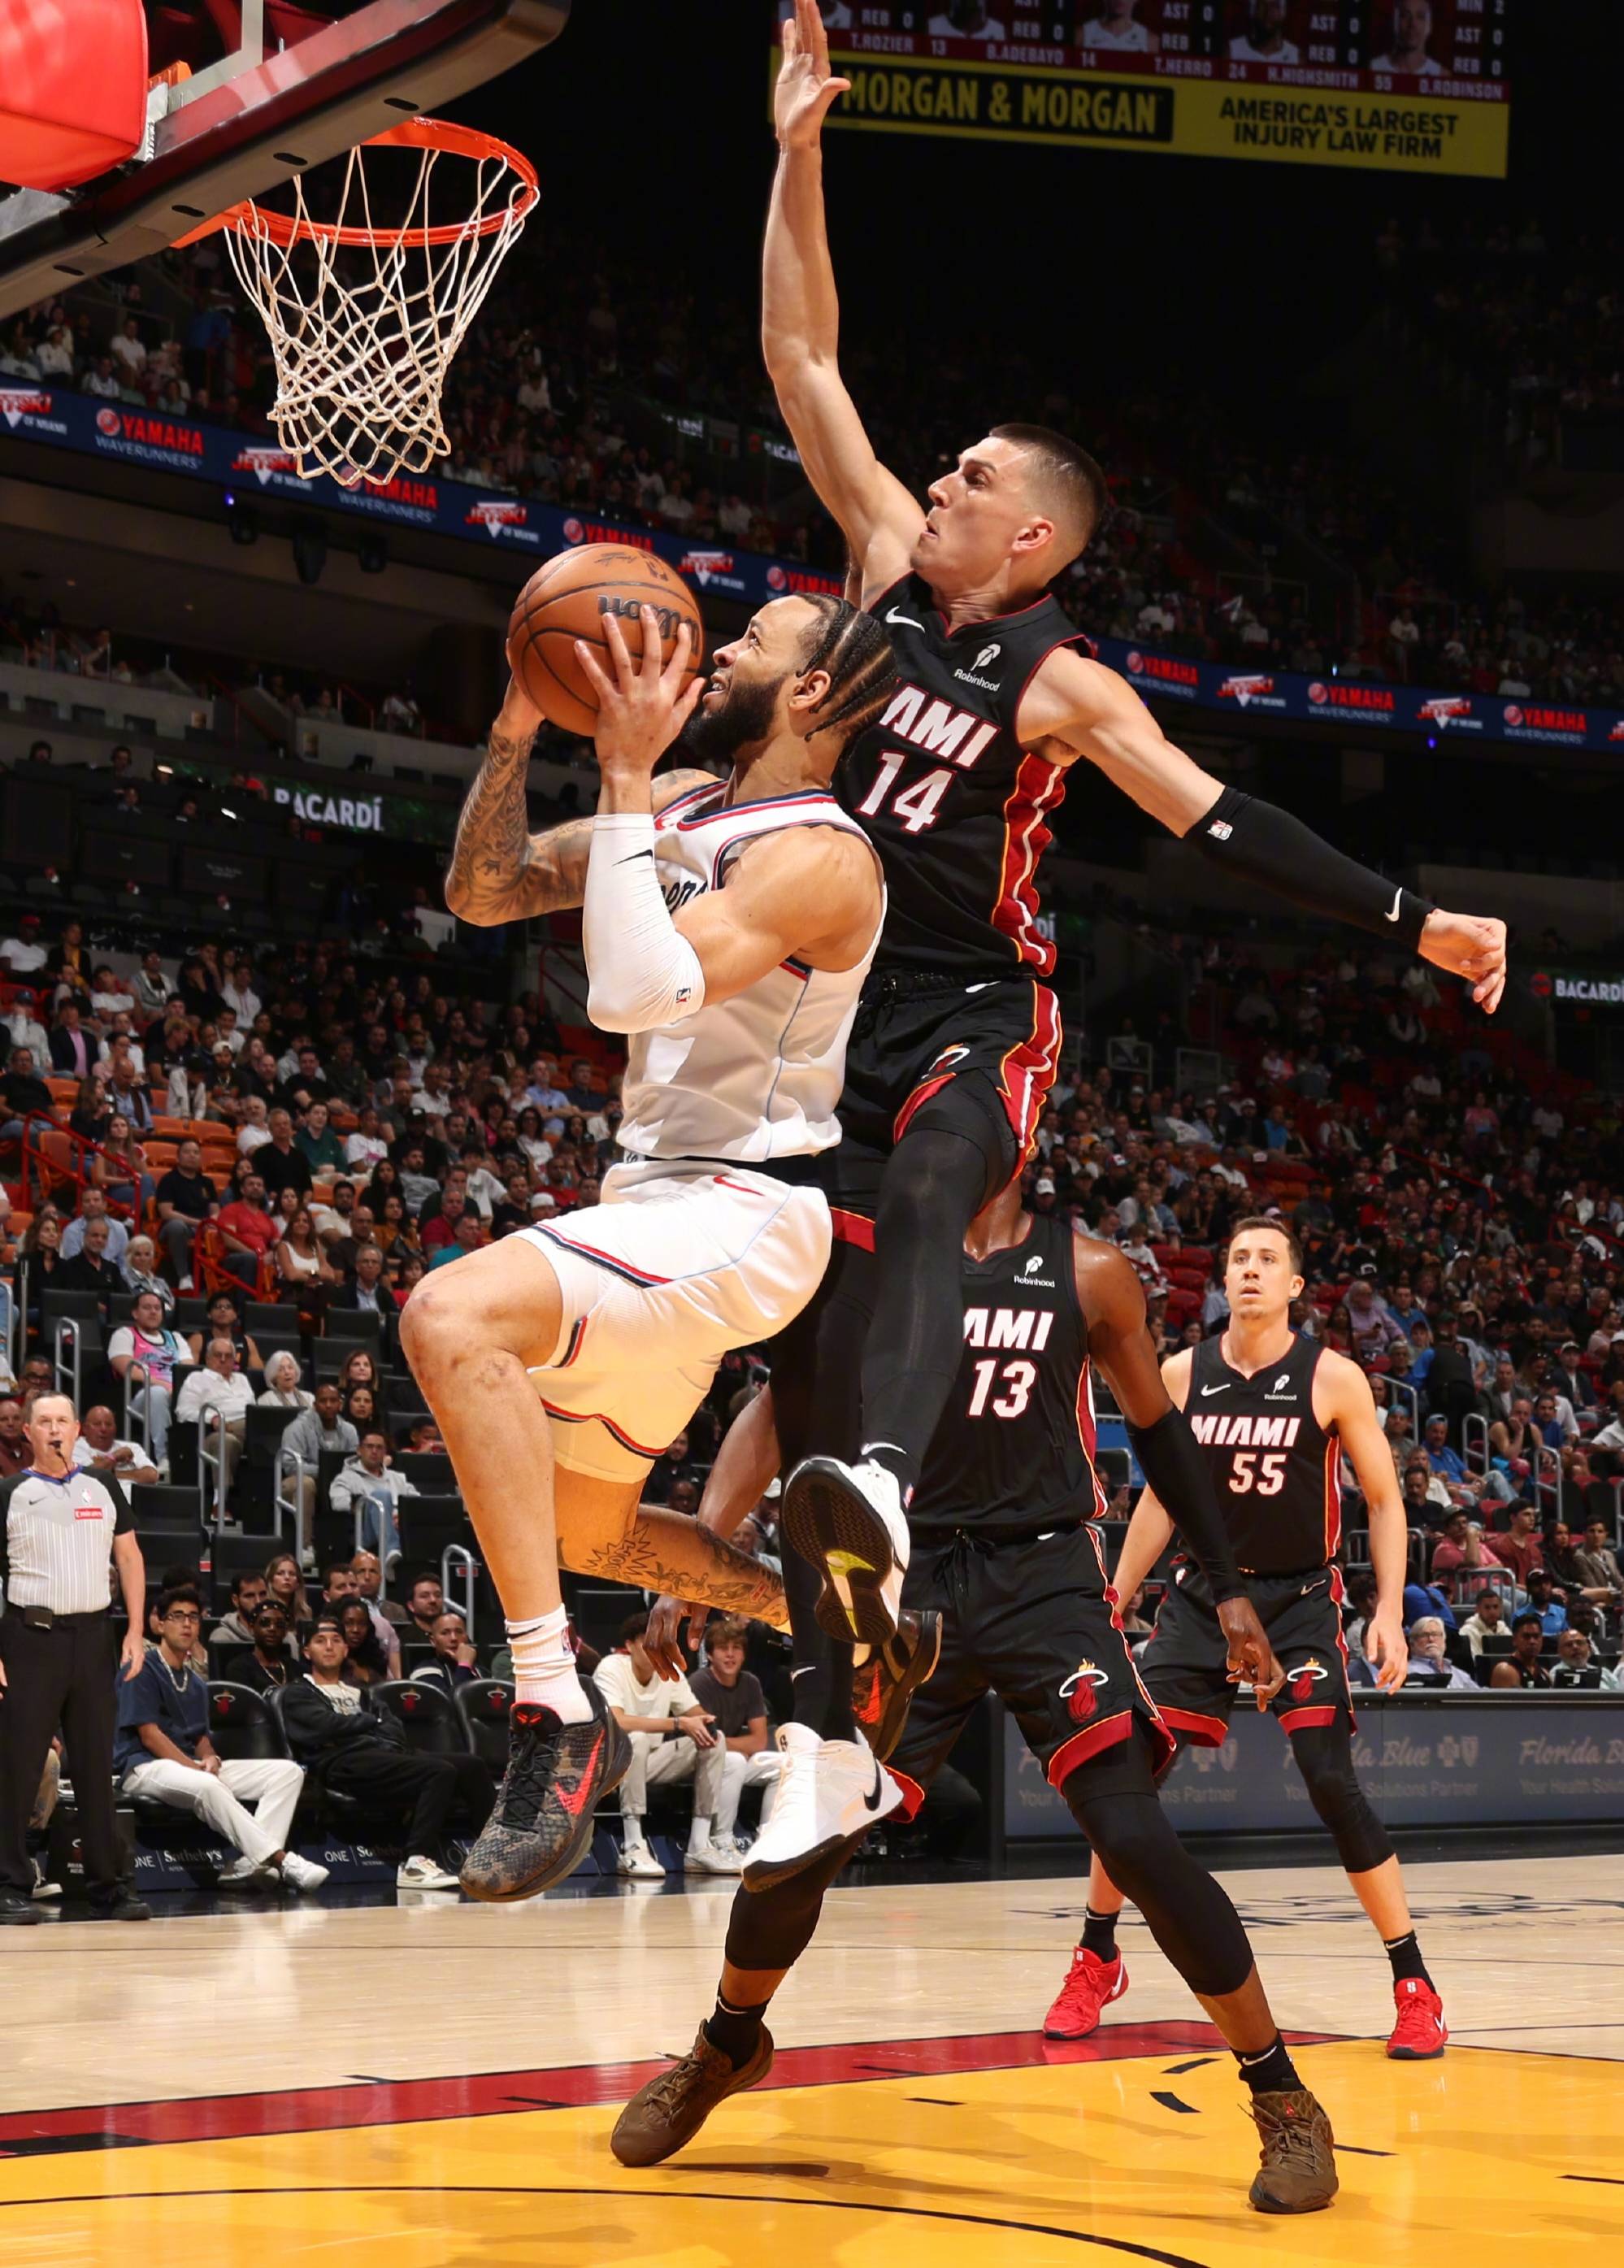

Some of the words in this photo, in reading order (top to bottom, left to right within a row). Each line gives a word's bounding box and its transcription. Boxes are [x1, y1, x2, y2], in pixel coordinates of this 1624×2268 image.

[862, 8, 890, 27] REB
[1162, 2, 1190, 21] AST
[1013, 20, 1041, 40] REB
[1309, 14, 1337, 33] AST
[1162, 33, 1189, 51] REB
[1455, 27, 1482, 44] AST
[931, 39, 948, 57] 13
[1309, 44, 1336, 63] REB
[1080, 50, 1096, 67] 14
[1153, 57, 1213, 78] T.HERRO
[1453, 55, 1481, 75] REB
[1228, 63, 1248, 80] 24
[841, 69, 977, 120] MORGAN
[988, 80, 1012, 124] &
[1021, 83, 1157, 134] MORGAN
[1219, 96, 1348, 128] AMERICA'S
[1353, 107, 1459, 137] LARGEST
[1234, 122, 1322, 150] INJURY
[1327, 129, 1378, 154] LAW
[1383, 134, 1443, 159] FIRM
[122, 413, 206, 456] YAMAHA
[94, 434, 202, 471] WAVERUNNERS
[337, 490, 433, 523] WAVERUNNERS
[954, 667, 1001, 692] Robinhood
[1144, 655, 1200, 687] YAMAHA
[1328, 685, 1396, 712] YAMAHA
[1307, 705, 1392, 723] WAVERUNNERS
[1523, 708, 1587, 732] YAMAHA
[878, 681, 1001, 770] AMI
[1503, 728, 1584, 745] WAVERUNNERS
[857, 749, 957, 834] 14
[1014, 1275, 1055, 1288] Robinhood
[963, 1307, 1055, 1352] AMI
[967, 1358, 1038, 1419] 13
[1264, 1393, 1297, 1401] Robinhood
[1191, 1414, 1301, 1448] MIAMI
[1228, 1452, 1287, 1495] 55
[1379, 1736, 1431, 1768] Blue
[1518, 1734, 1600, 1766] Florida
[1184, 1787, 1237, 1804] Partner
[1429, 1779, 1479, 1798] Partner
[163, 1848, 223, 1864] Sotheby's
[324, 1849, 350, 1863] ONE
